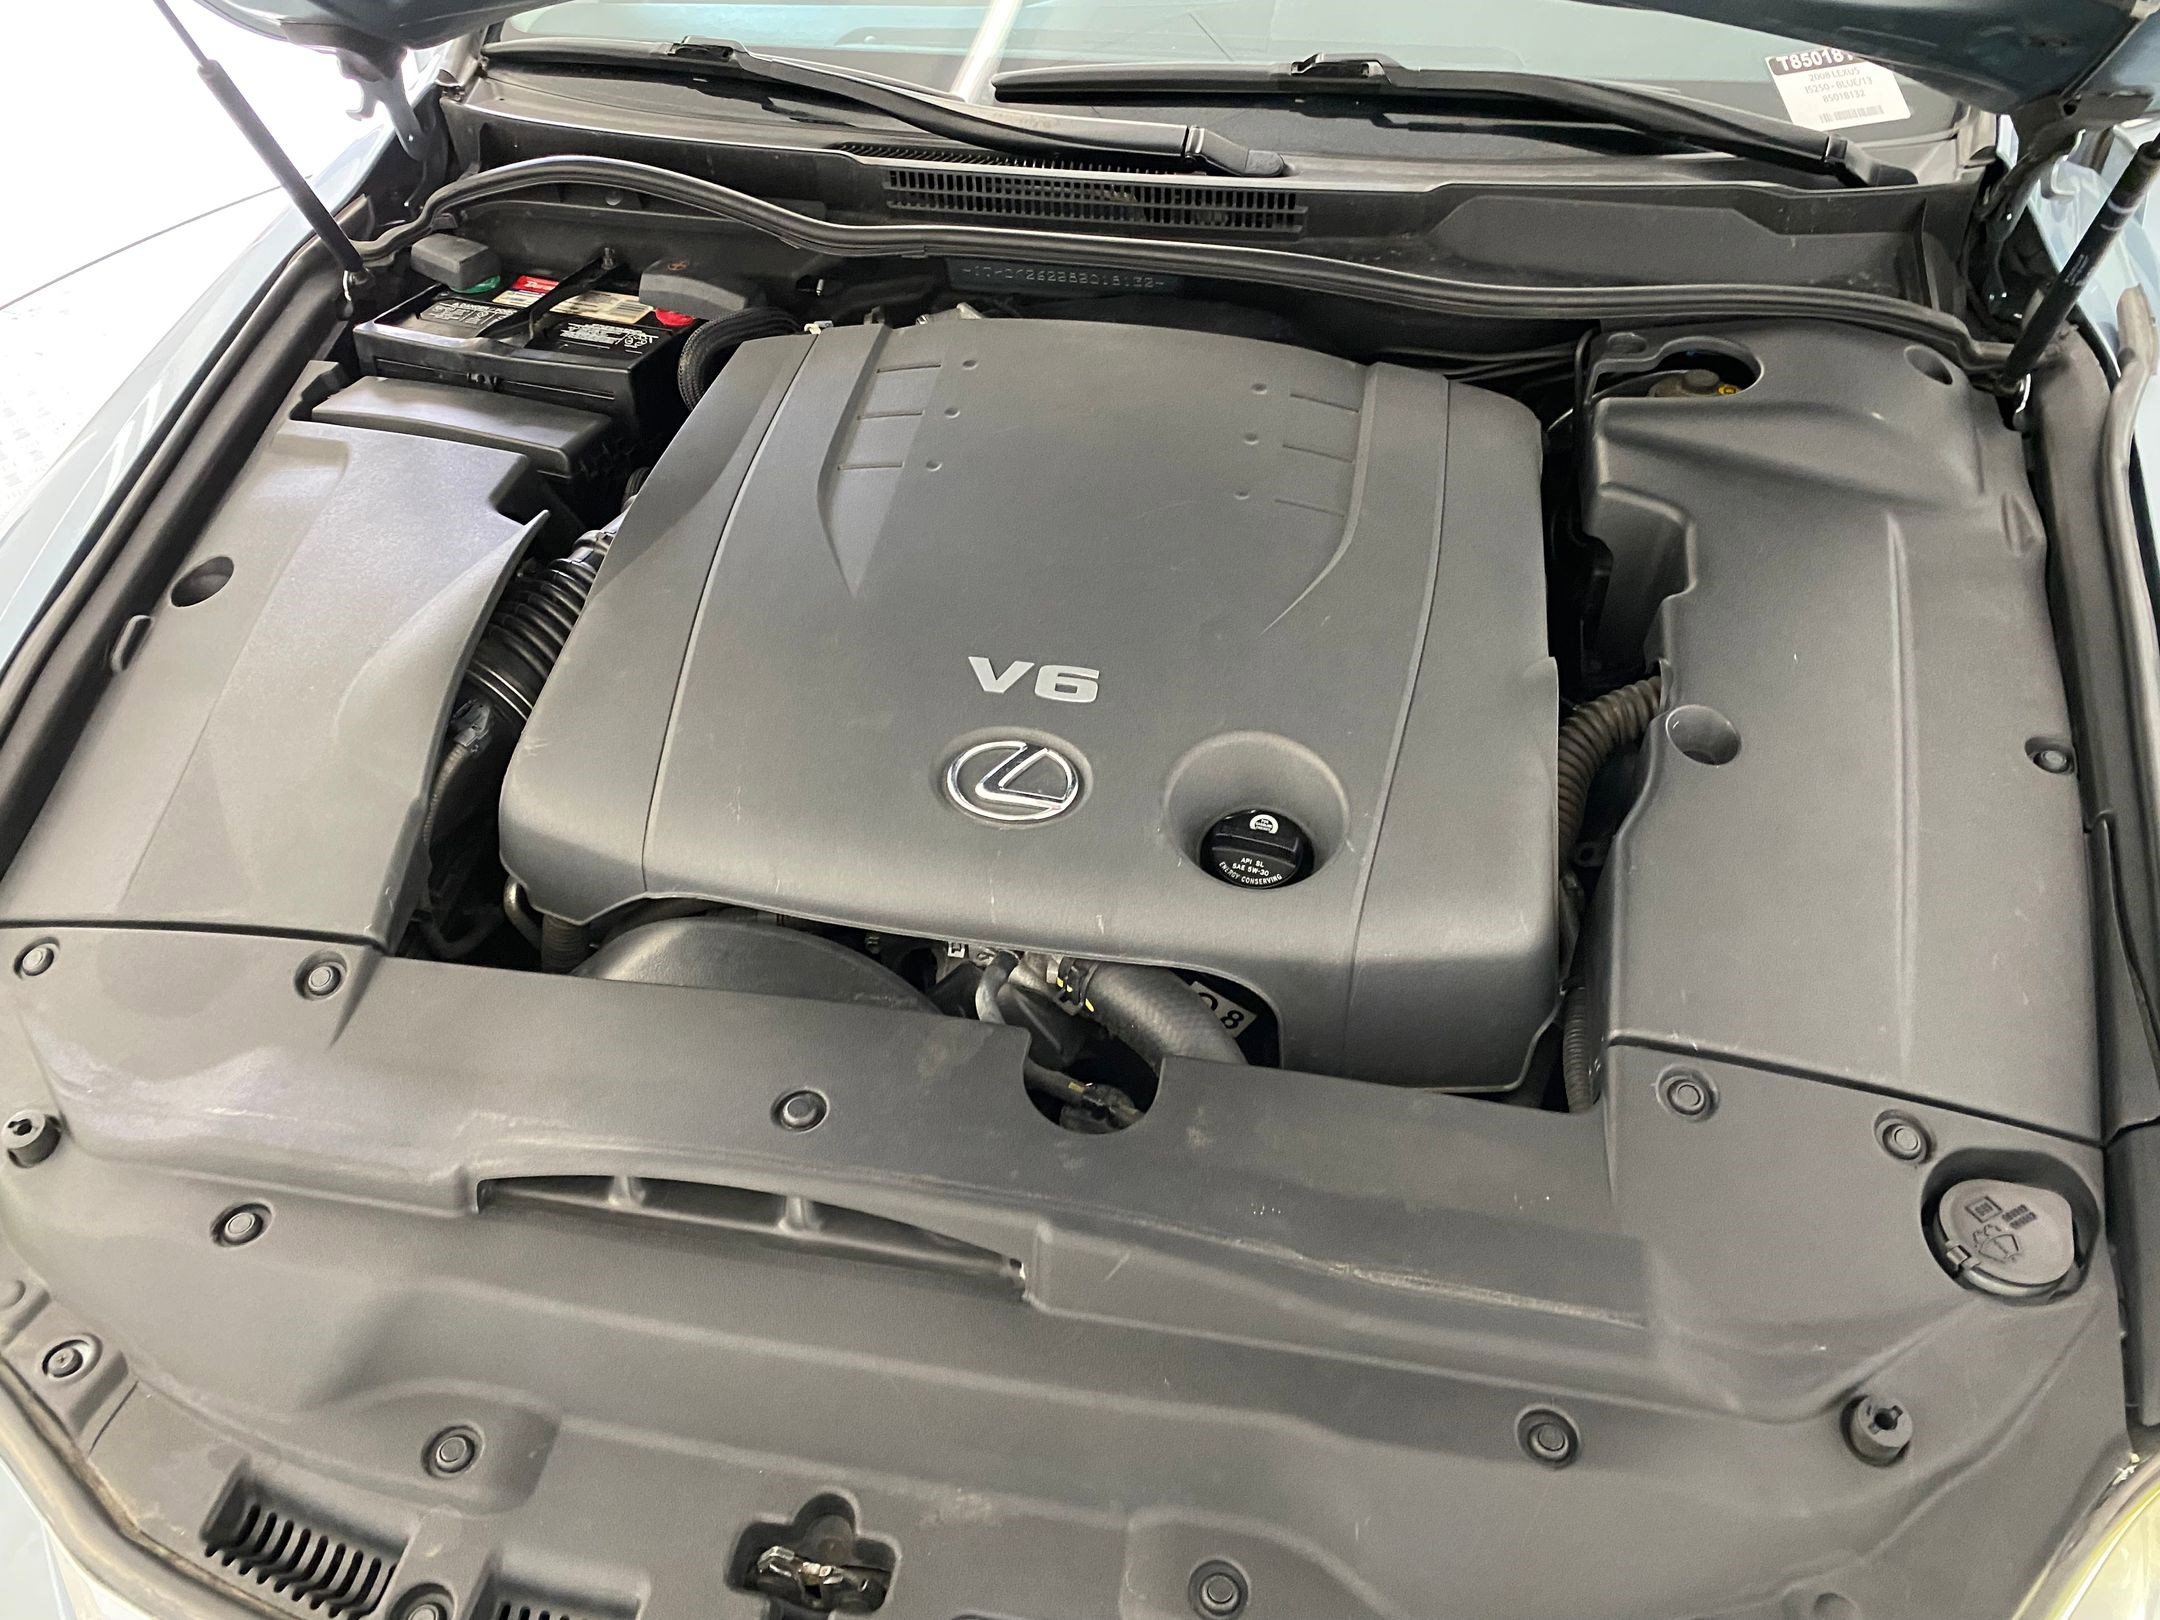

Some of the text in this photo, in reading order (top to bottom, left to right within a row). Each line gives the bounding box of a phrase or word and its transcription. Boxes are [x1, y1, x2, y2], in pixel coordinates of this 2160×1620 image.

[1832, 67, 1860, 79] LEXUS
[968, 656, 1100, 703] V6
[1240, 857, 1264, 868] API SL
[1219, 861, 1283, 885] ENERGY CONSERVING
[1232, 863, 1270, 877] SAE 5W-30
